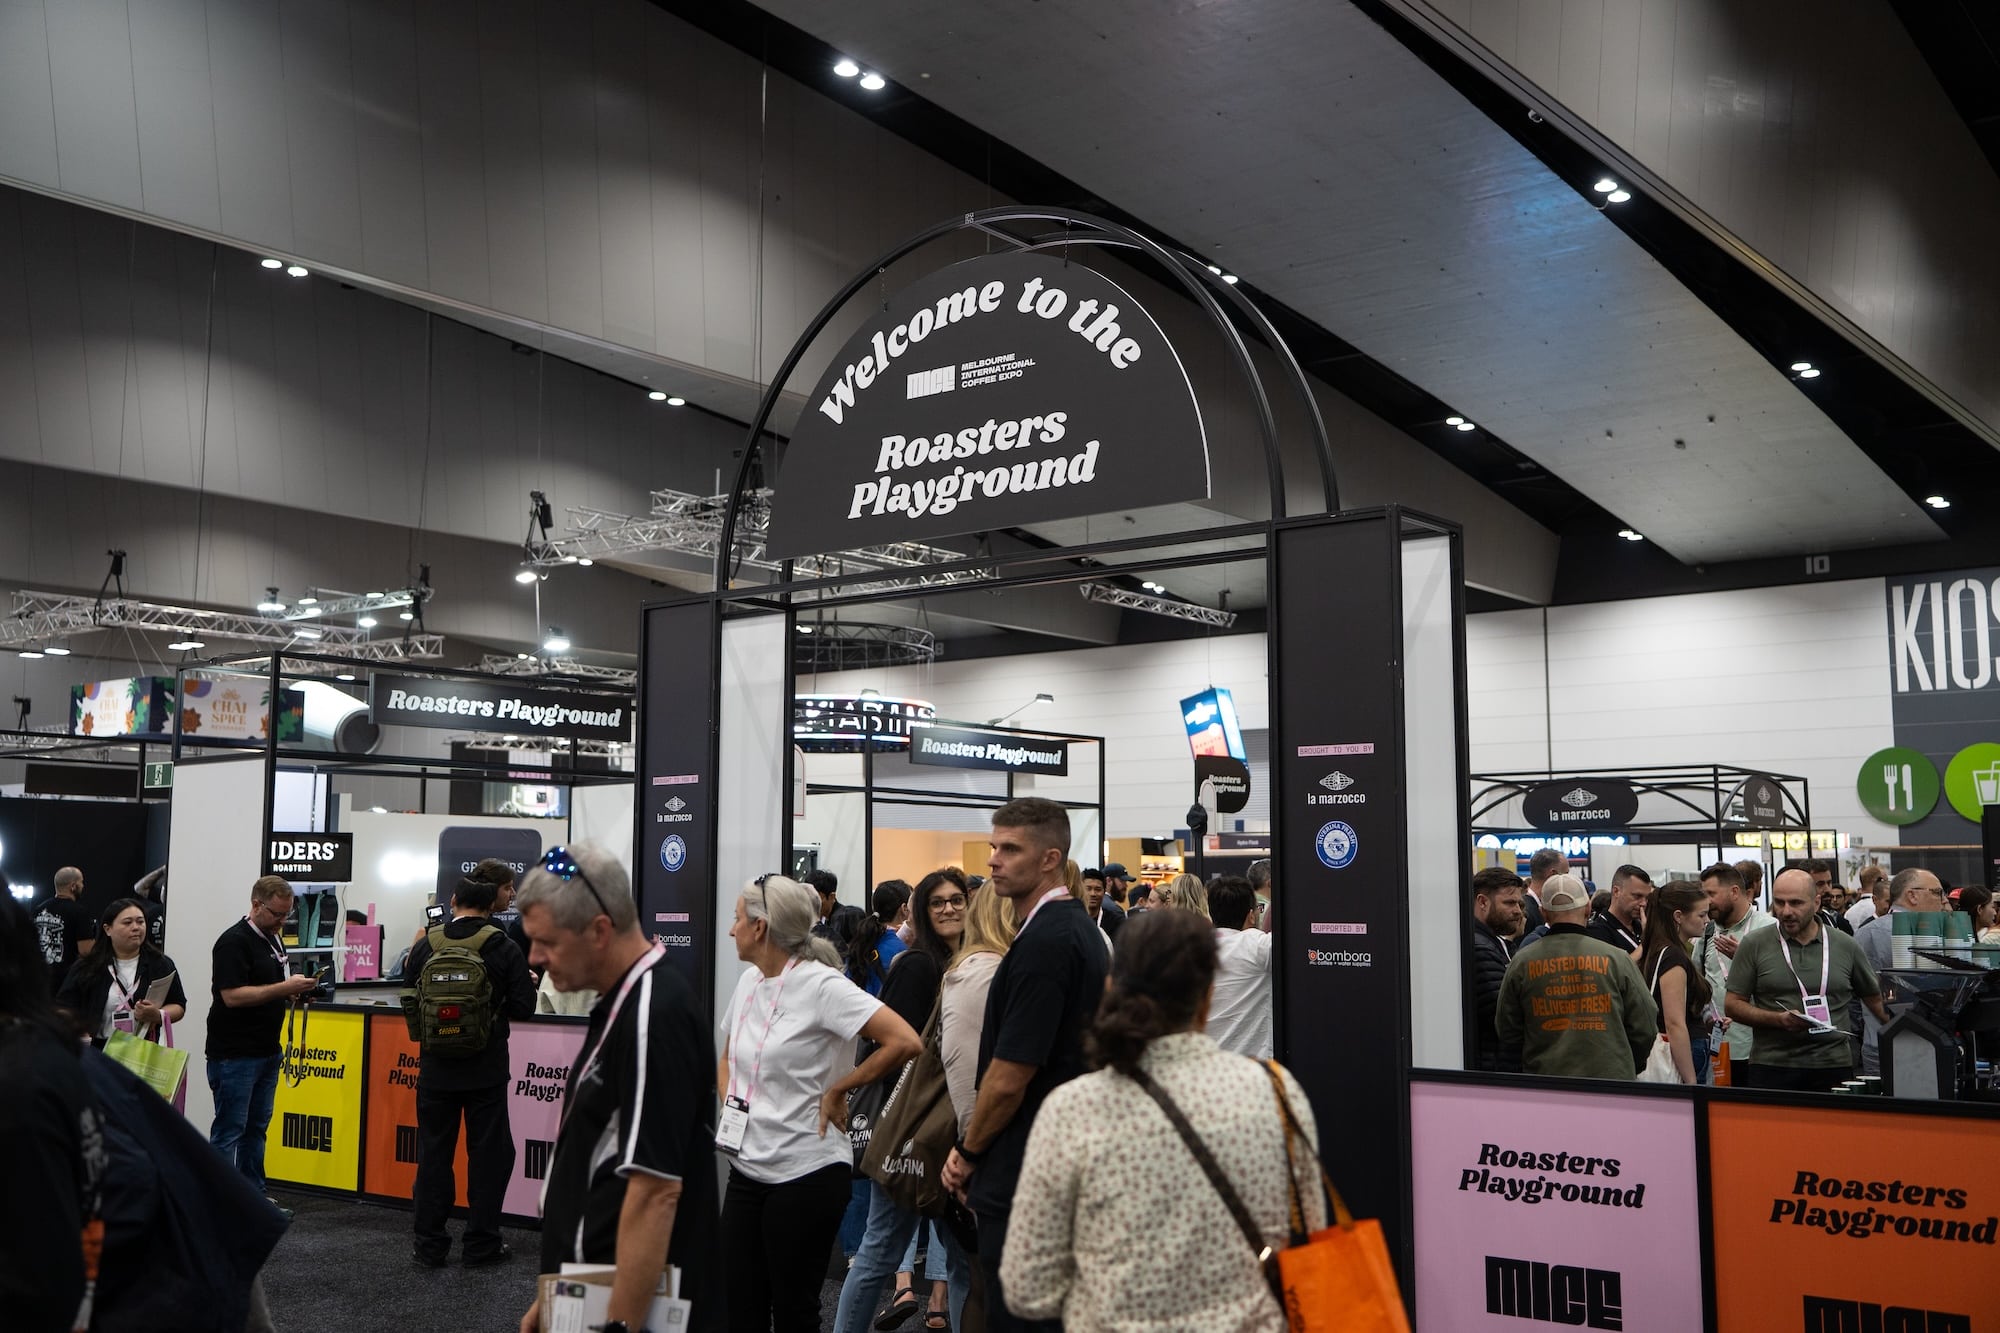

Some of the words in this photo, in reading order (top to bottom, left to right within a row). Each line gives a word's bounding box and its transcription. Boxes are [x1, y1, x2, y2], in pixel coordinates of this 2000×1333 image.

[819, 280, 1005, 425] Welcome
[1016, 277, 1068, 319] to
[1067, 298, 1141, 370] the
[961, 353, 1015, 371] MELBOURNE
[961, 358, 1036, 380] INTERNATIONAL
[961, 375, 997, 388] COFFEE
[998, 370, 1024, 381] EXPO
[874, 411, 1068, 473] Roasters
[847, 440, 1100, 519] Playground
[1892, 578, 2000, 693] KIO
[211, 700, 248, 714] CHAI
[387, 689, 494, 717] Roasters
[496, 699, 622, 727] Playground
[211, 713, 247, 725] SPICE
[921, 738, 985, 759] Roasters
[985, 743, 1063, 766] Playground
[1300, 747, 1329, 755] BROUGHT
[1346, 745, 1359, 753] YOU
[1363, 744, 1373, 752] BY
[1307, 793, 1317, 805] la
[1318, 793, 1366, 805] marzocco
[663, 813, 693, 823] marzocco
[1549, 809, 1559, 821] la
[1561, 809, 1610, 821] marzocco
[273, 864, 312, 872] ROASTERS
[1312, 924, 1352, 932] SUPPORTED
[1317, 949, 1372, 962] bombora
[1528, 955, 1576, 980] ROASTED
[1577, 954, 1609, 976] DAILY
[1545, 983, 1598, 996] GROUNDS
[1561, 974, 1581, 983] THE
[1580, 992, 1611, 1014] FRESH
[1571, 1021, 1607, 1031] COFFEE
[282, 1111, 333, 1153] MICE
[1477, 1143, 1621, 1177] Roasters
[1458, 1168, 1646, 1209] Playground
[1791, 1171, 1968, 1210] Roasters
[1769, 1198, 1999, 1245] Playground
[1485, 1255, 1623, 1331] MICE
